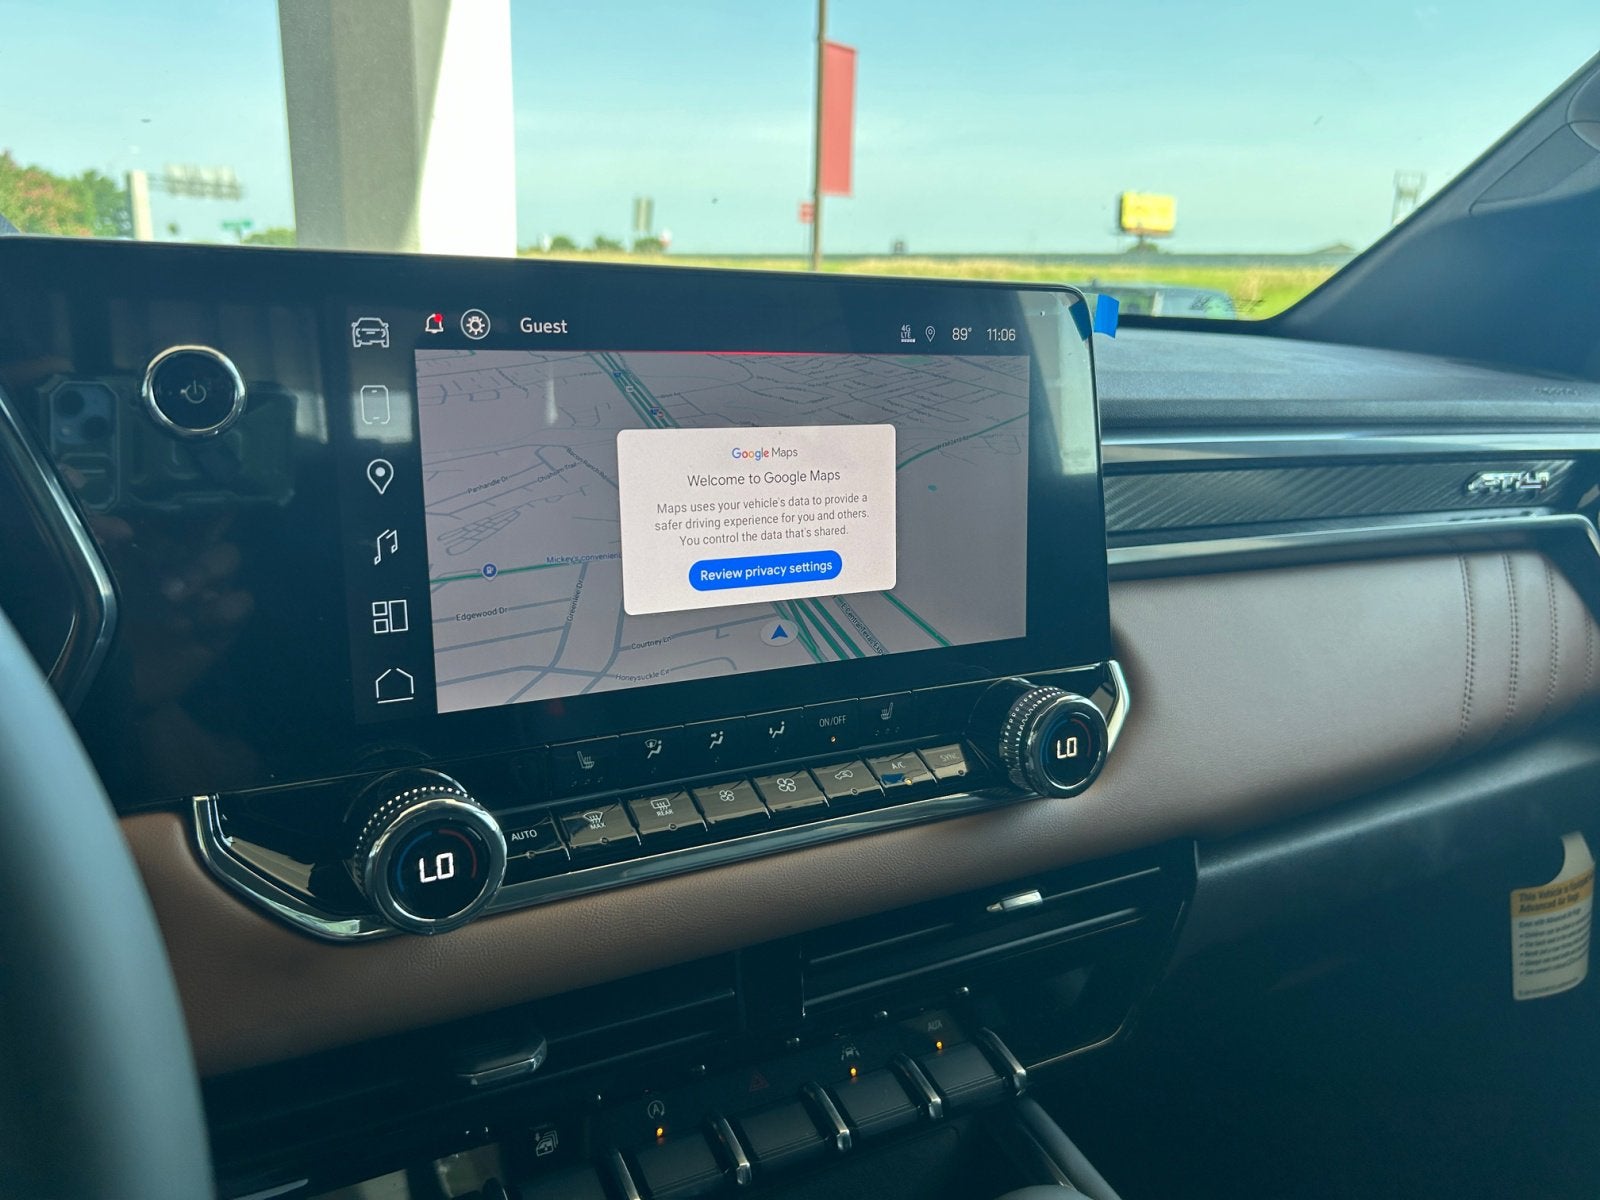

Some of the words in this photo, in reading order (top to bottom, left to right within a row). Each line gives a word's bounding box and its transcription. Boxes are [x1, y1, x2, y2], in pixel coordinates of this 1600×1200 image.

[520, 317, 568, 333] Guest
[901, 324, 911, 332] 4G
[952, 327, 973, 341] 89°
[986, 328, 1016, 341] 11:06
[731, 447, 769, 461] Google
[771, 447, 798, 459] Maps
[565, 462, 577, 471] Trail
[687, 474, 745, 486] Welcome
[749, 473, 761, 484] to
[764, 470, 807, 485] Google
[810, 469, 841, 484] Maps
[467, 477, 499, 494] Panhandle
[657, 503, 687, 515] Maps
[690, 502, 715, 512] uses
[718, 500, 740, 512] your
[743, 497, 785, 509] vehicle's
[788, 496, 810, 507] data
[812, 494, 822, 505] to
[824, 493, 859, 507] provide
[862, 494, 868, 502] a
[654, 519, 682, 531] safer
[685, 518, 721, 530] driving
[723, 515, 778, 528] experience
[781, 512, 794, 523] for
[797, 513, 815, 524] you
[817, 510, 835, 520] and
[837, 509, 869, 519] others.
[679, 535, 700, 546] You
[703, 532, 739, 544] control
[741, 531, 757, 542] the
[760, 530, 782, 541] data
[785, 527, 811, 538] that's
[814, 525, 848, 537] shared.
[700, 568, 742, 581] Review
[745, 565, 787, 580] privacy
[789, 561, 832, 574] settings
[456, 608, 497, 621] Edgewood
[498, 606, 508, 614] Dr
[631, 638, 662, 650] Courtney
[615, 670, 659, 682] Honeysuckle
[819, 715, 847, 727] ON/OFF
[1056, 736, 1077, 759] LO
[891, 761, 906, 770] A/C
[656, 808, 674, 817] REAR
[590, 822, 606, 830] MAX
[511, 829, 538, 841] AUTO
[418, 852, 455, 883] LO
